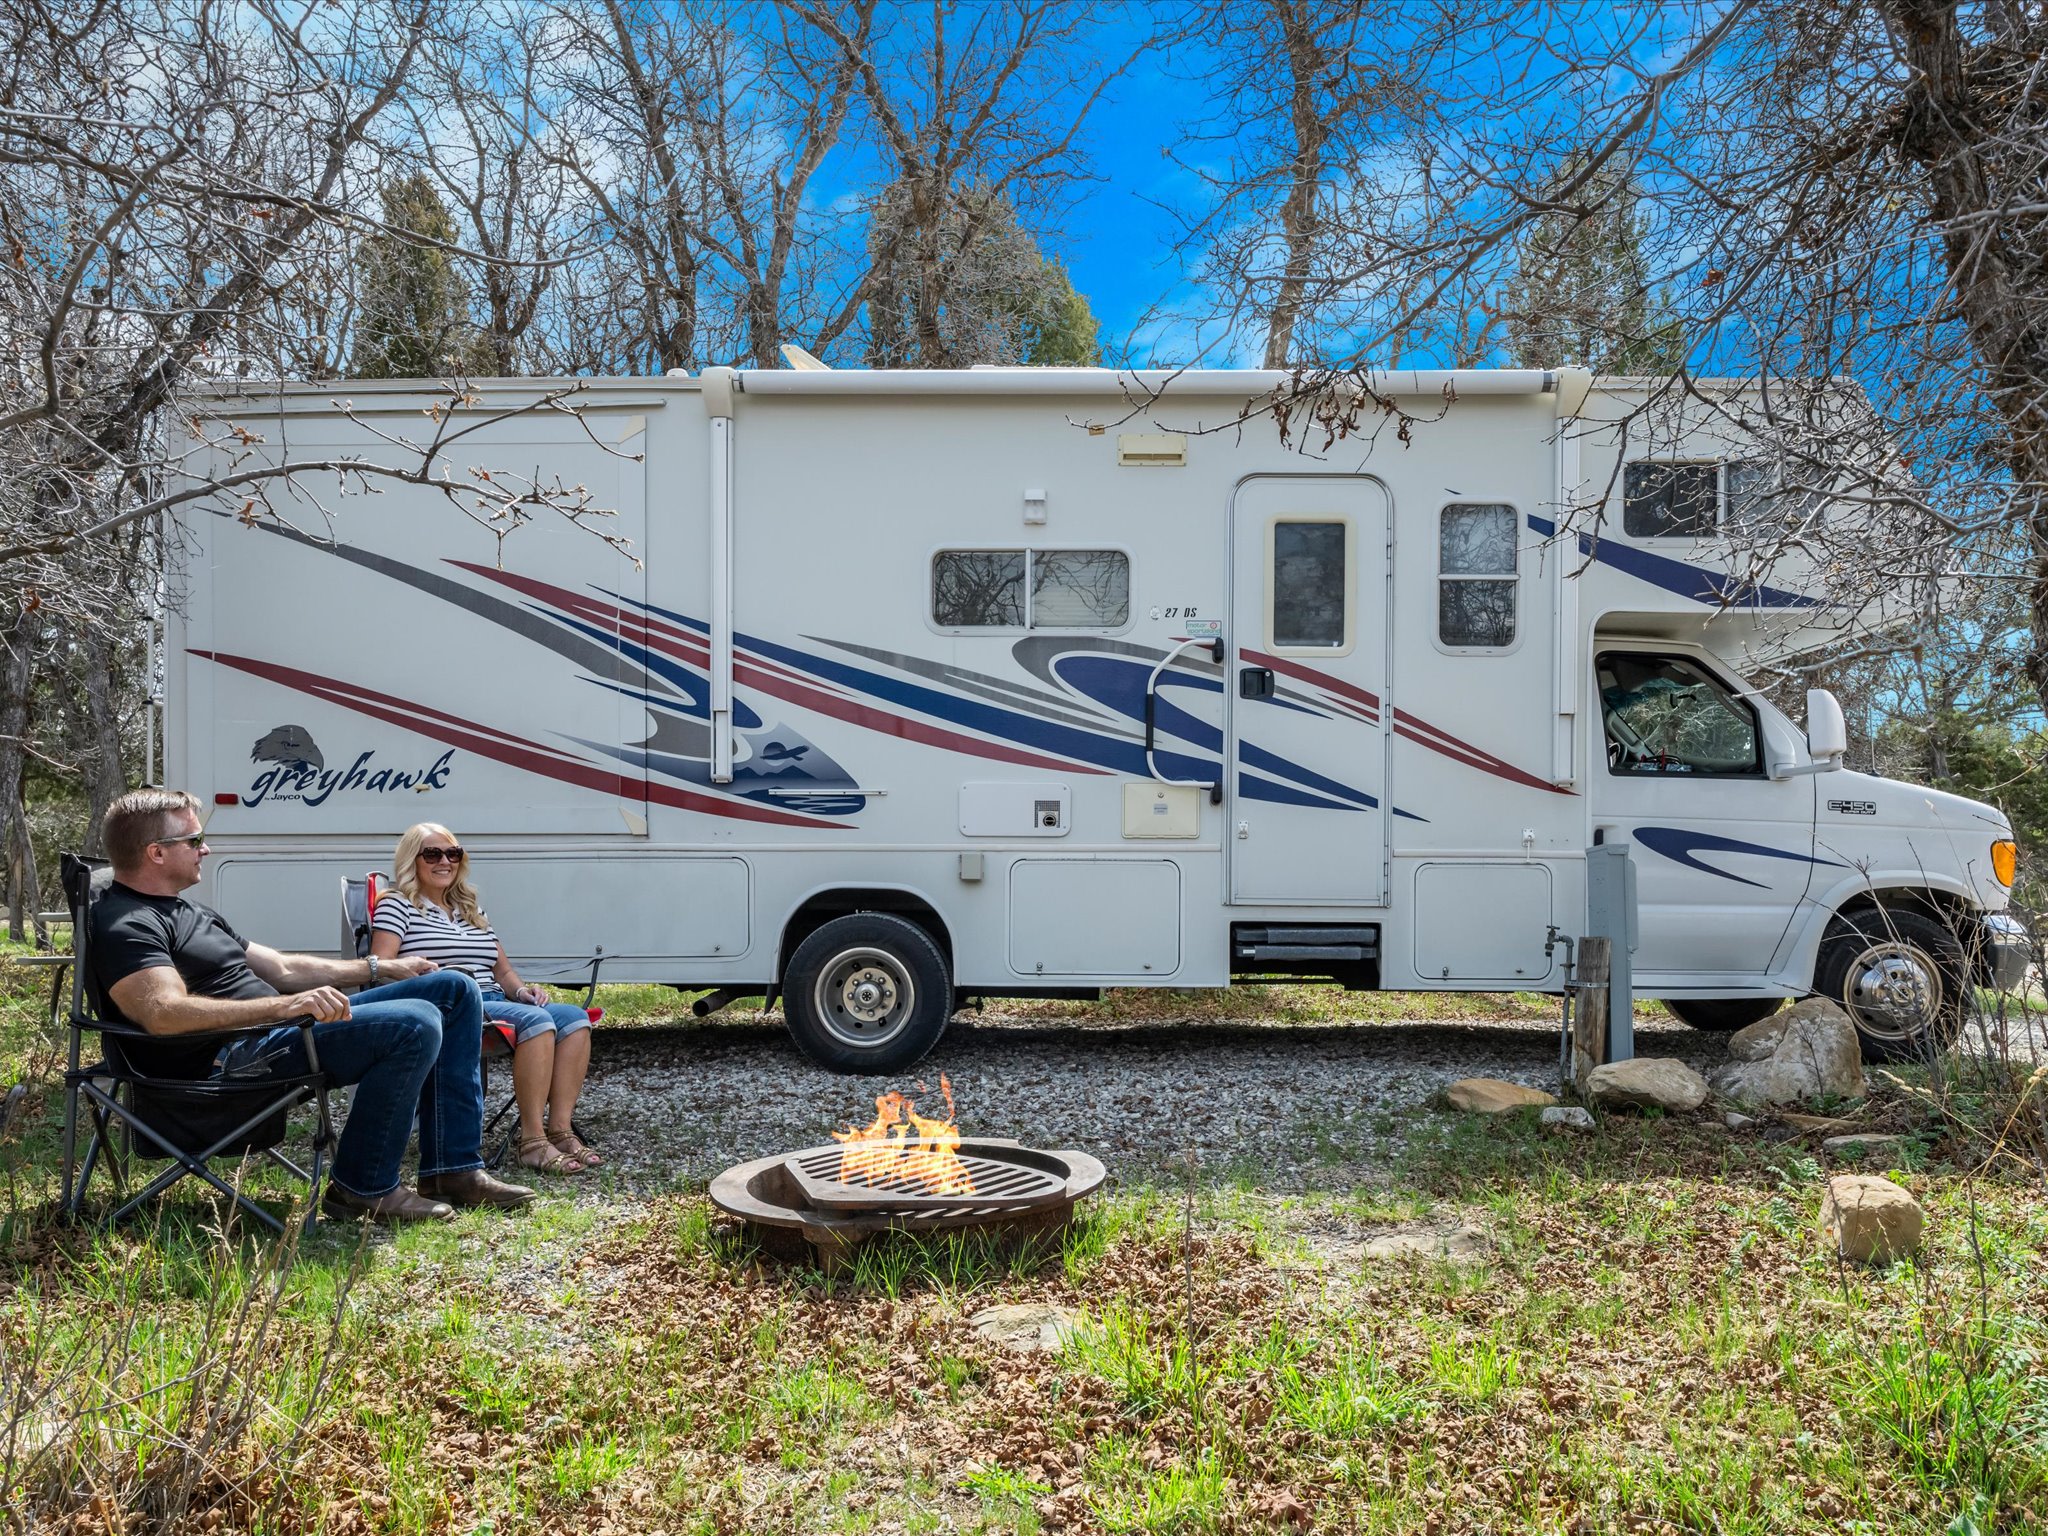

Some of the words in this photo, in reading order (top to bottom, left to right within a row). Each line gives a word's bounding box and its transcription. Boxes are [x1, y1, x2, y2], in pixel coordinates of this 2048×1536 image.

[1164, 607, 1178, 618] 27
[1183, 607, 1198, 618] DS
[241, 748, 456, 808] greyhawk
[271, 793, 301, 802] Jayco
